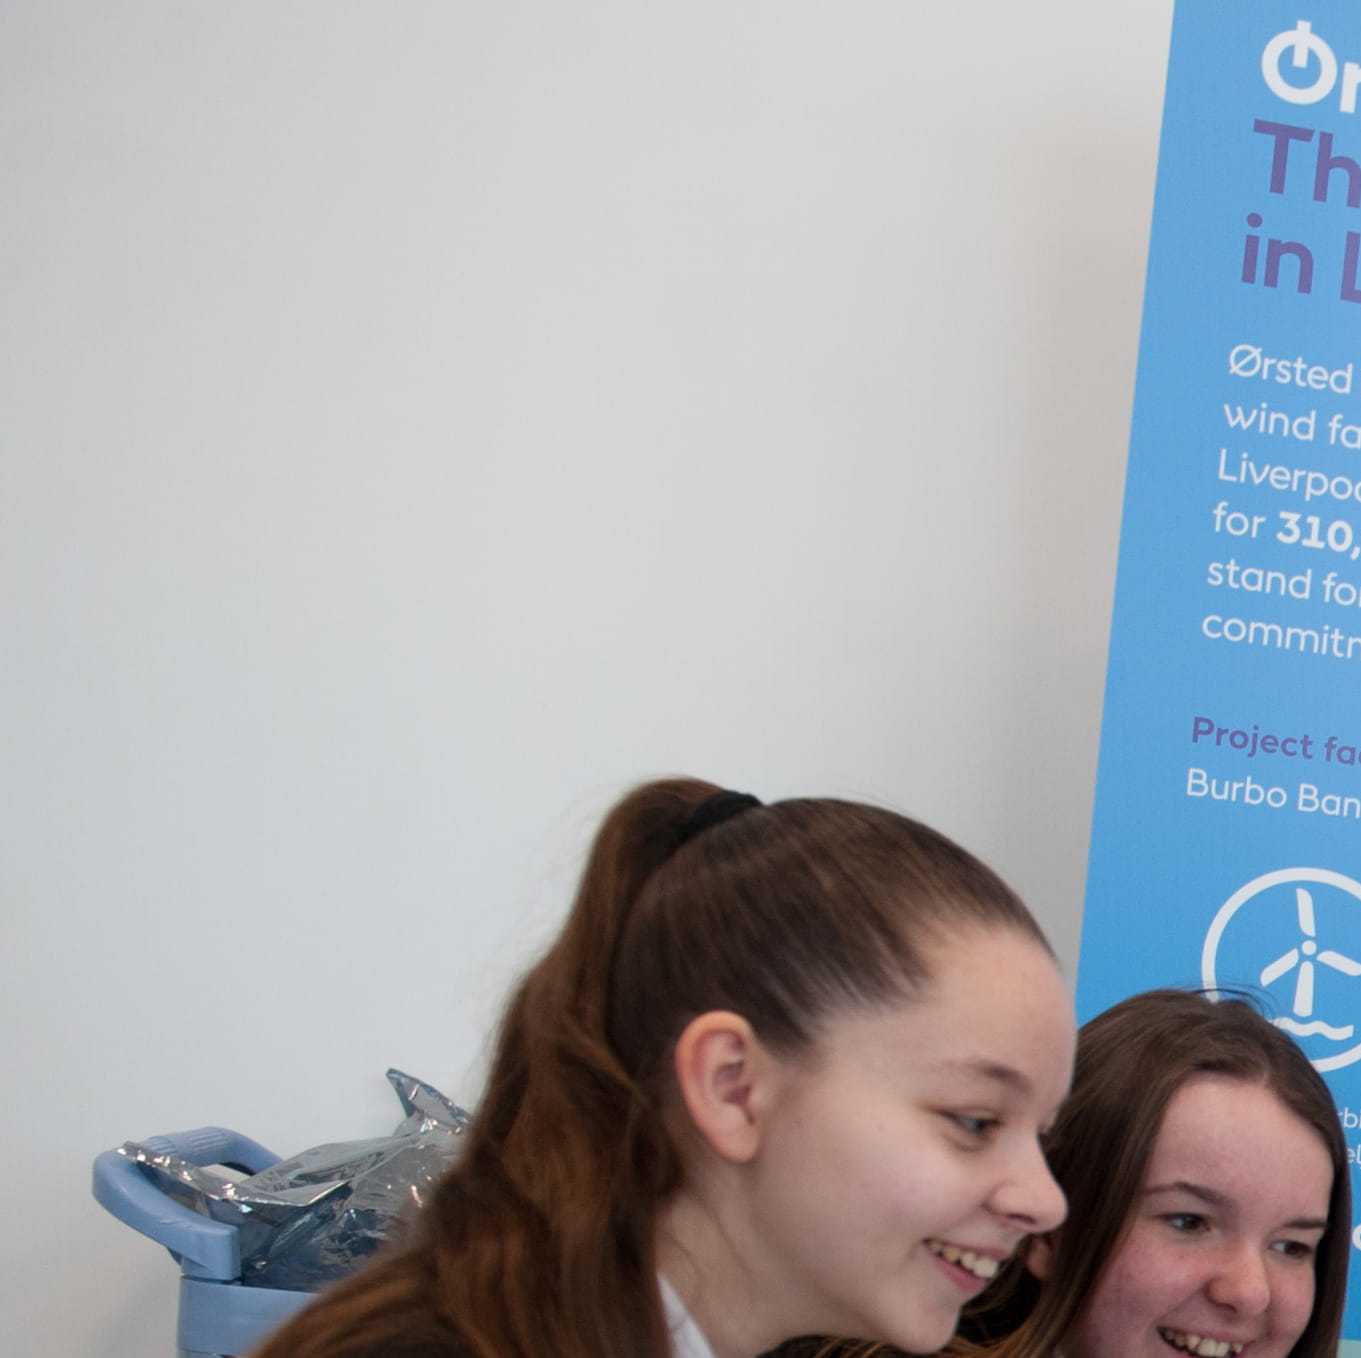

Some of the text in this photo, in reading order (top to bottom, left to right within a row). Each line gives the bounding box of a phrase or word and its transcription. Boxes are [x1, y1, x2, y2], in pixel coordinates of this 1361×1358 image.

[1242, 213, 1314, 294] in
[1229, 344, 1353, 394] Ørsted
[1224, 402, 1316, 440] wind
[1213, 501, 1266, 538] for
[1207, 559, 1312, 599] stand
[1192, 717, 1312, 759] Project
[1186, 768, 1287, 808] Burbo
